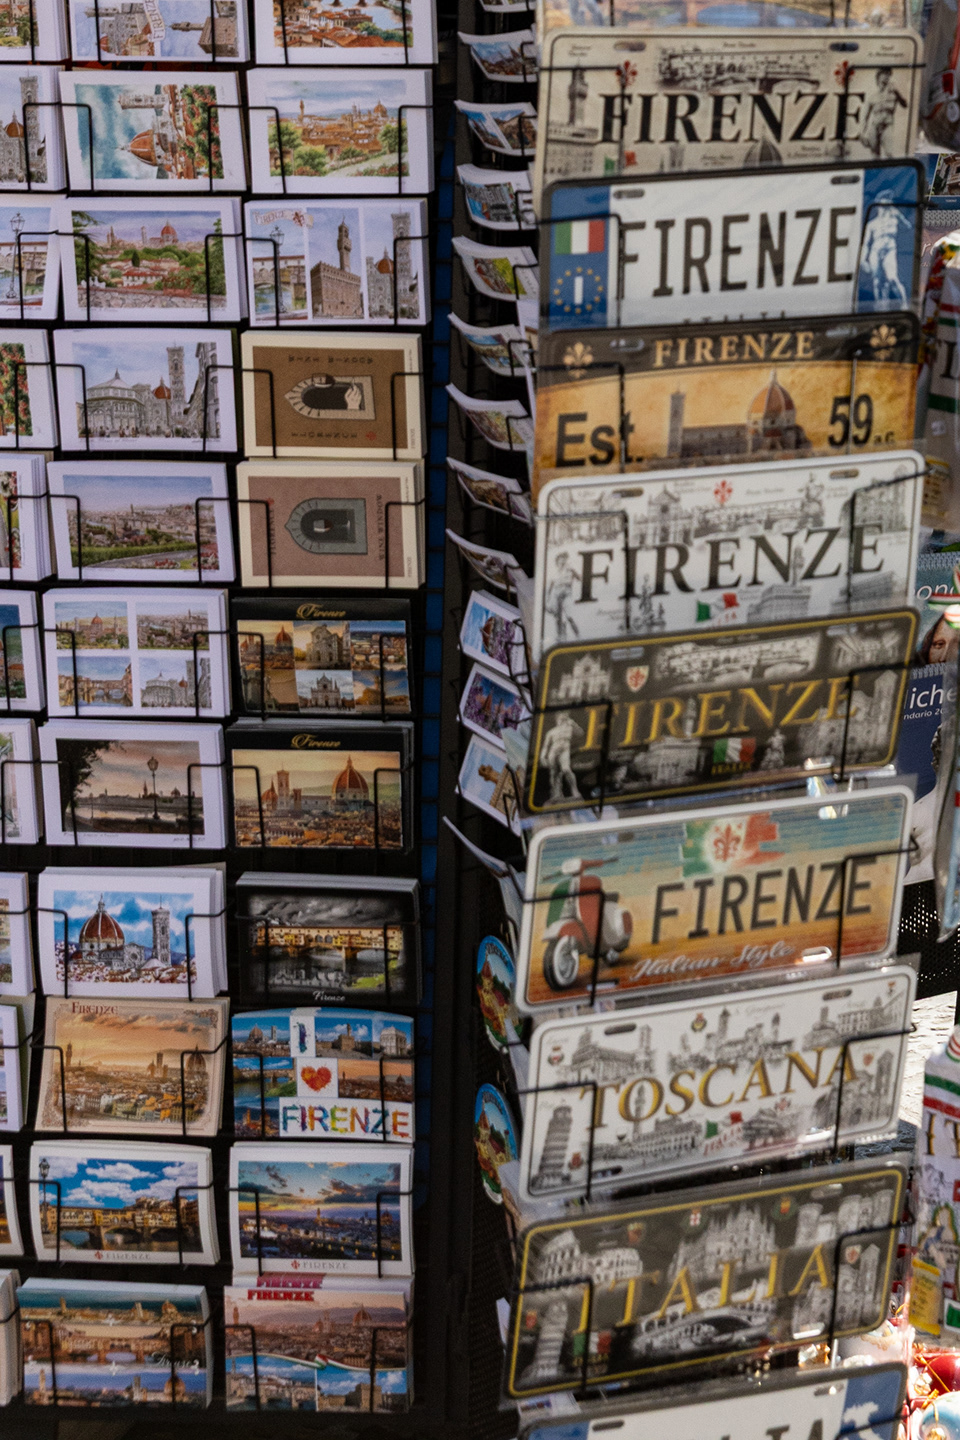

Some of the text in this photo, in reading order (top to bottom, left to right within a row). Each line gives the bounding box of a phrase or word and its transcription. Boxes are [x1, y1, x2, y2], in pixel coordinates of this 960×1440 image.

[599, 91, 866, 144] FIRENZE
[620, 206, 857, 300] FIRENZE
[653, 331, 816, 368] FIRENZE
[555, 410, 645, 468] Est.
[828, 393, 875, 447] 59
[575, 523, 886, 605] FIRENZE
[296, 603, 346, 619] Firenze
[579, 676, 861, 752] FIRENZE
[291, 733, 341, 749] Firenze
[651, 857, 878, 944] FIRENZE
[629, 940, 796, 981] Italian Style
[312, 990, 346, 1001] Firenze
[579, 1045, 862, 1129] TOSCANA
[282, 1104, 412, 1138] FIRENZE
[303, 1262, 347, 1270] FIRENZE
[571, 1243, 835, 1334] ITALIA
[248, 1289, 315, 1301] FIRENZE
